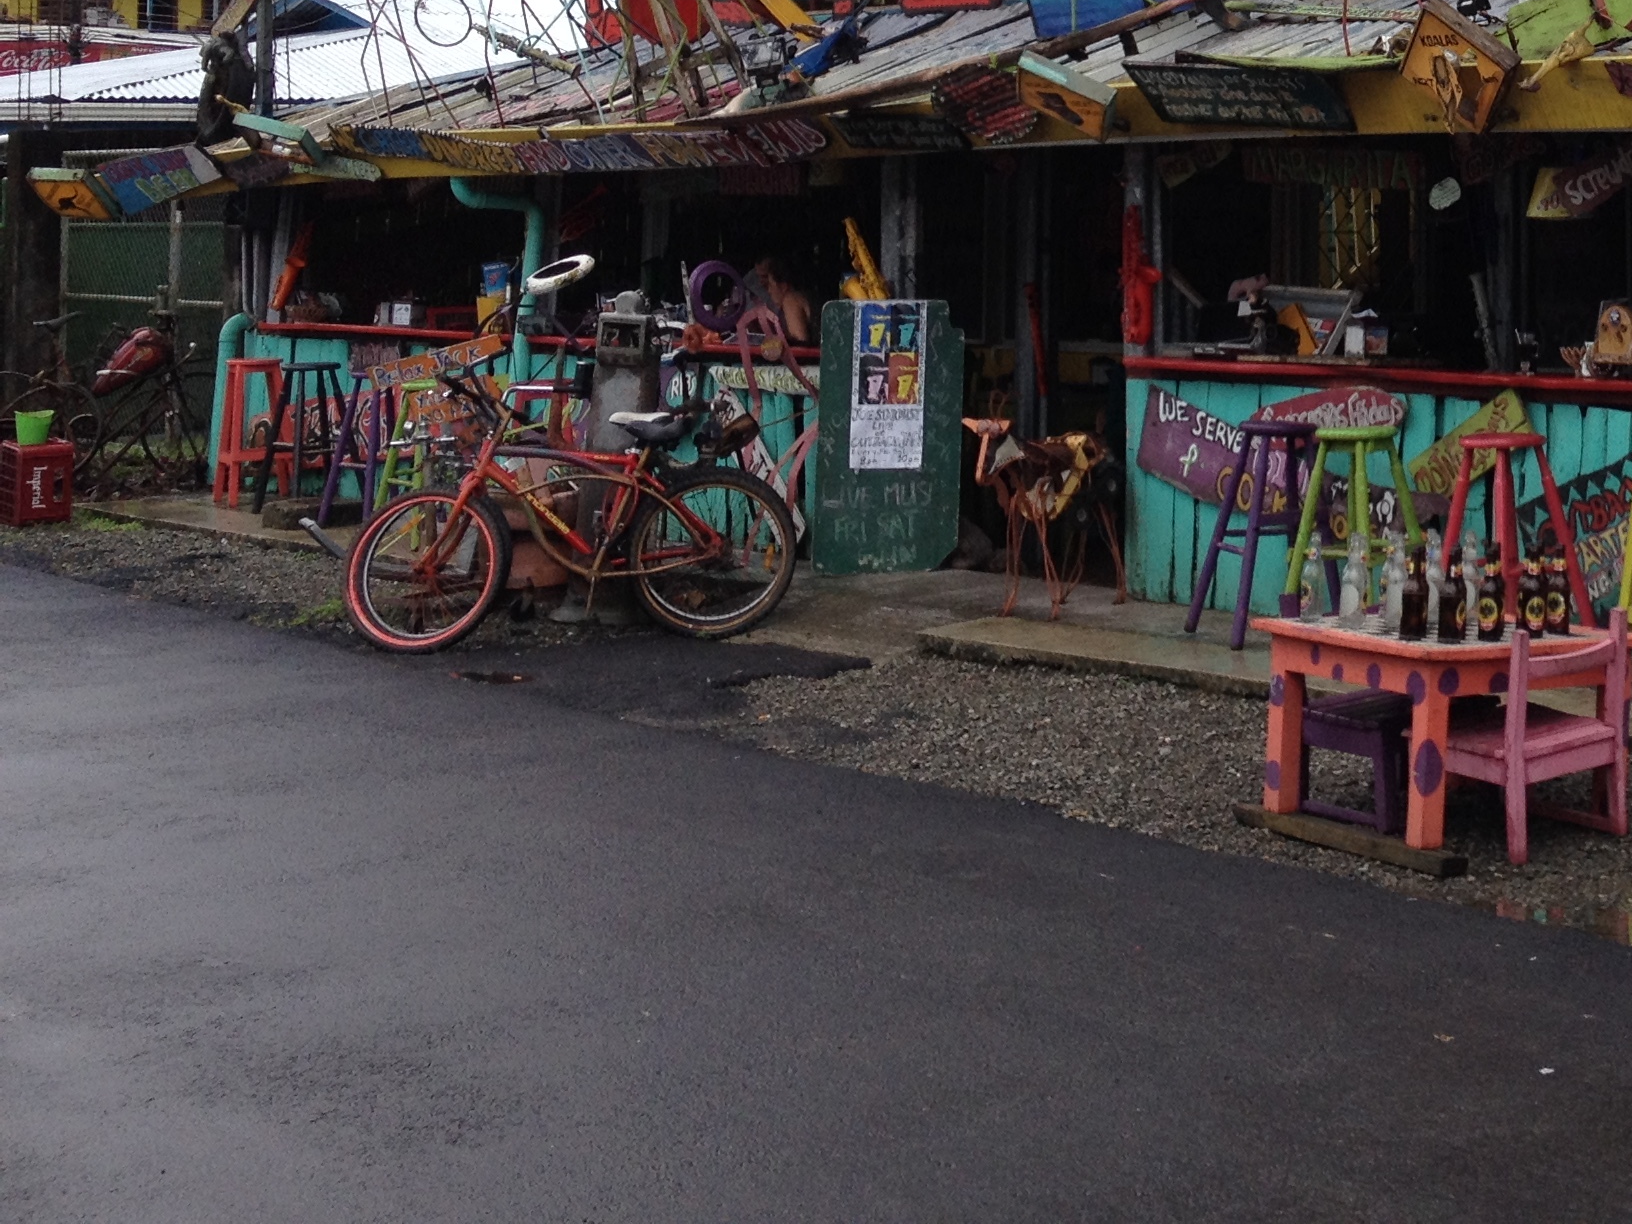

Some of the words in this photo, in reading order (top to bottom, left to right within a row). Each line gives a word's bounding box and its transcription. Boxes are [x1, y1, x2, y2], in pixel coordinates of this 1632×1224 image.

[1419, 34, 1459, 47] KOALAS
[1159, 391, 1190, 424] WE
[1192, 411, 1246, 453] SERVE
[26, 466, 48, 509] Imperial
